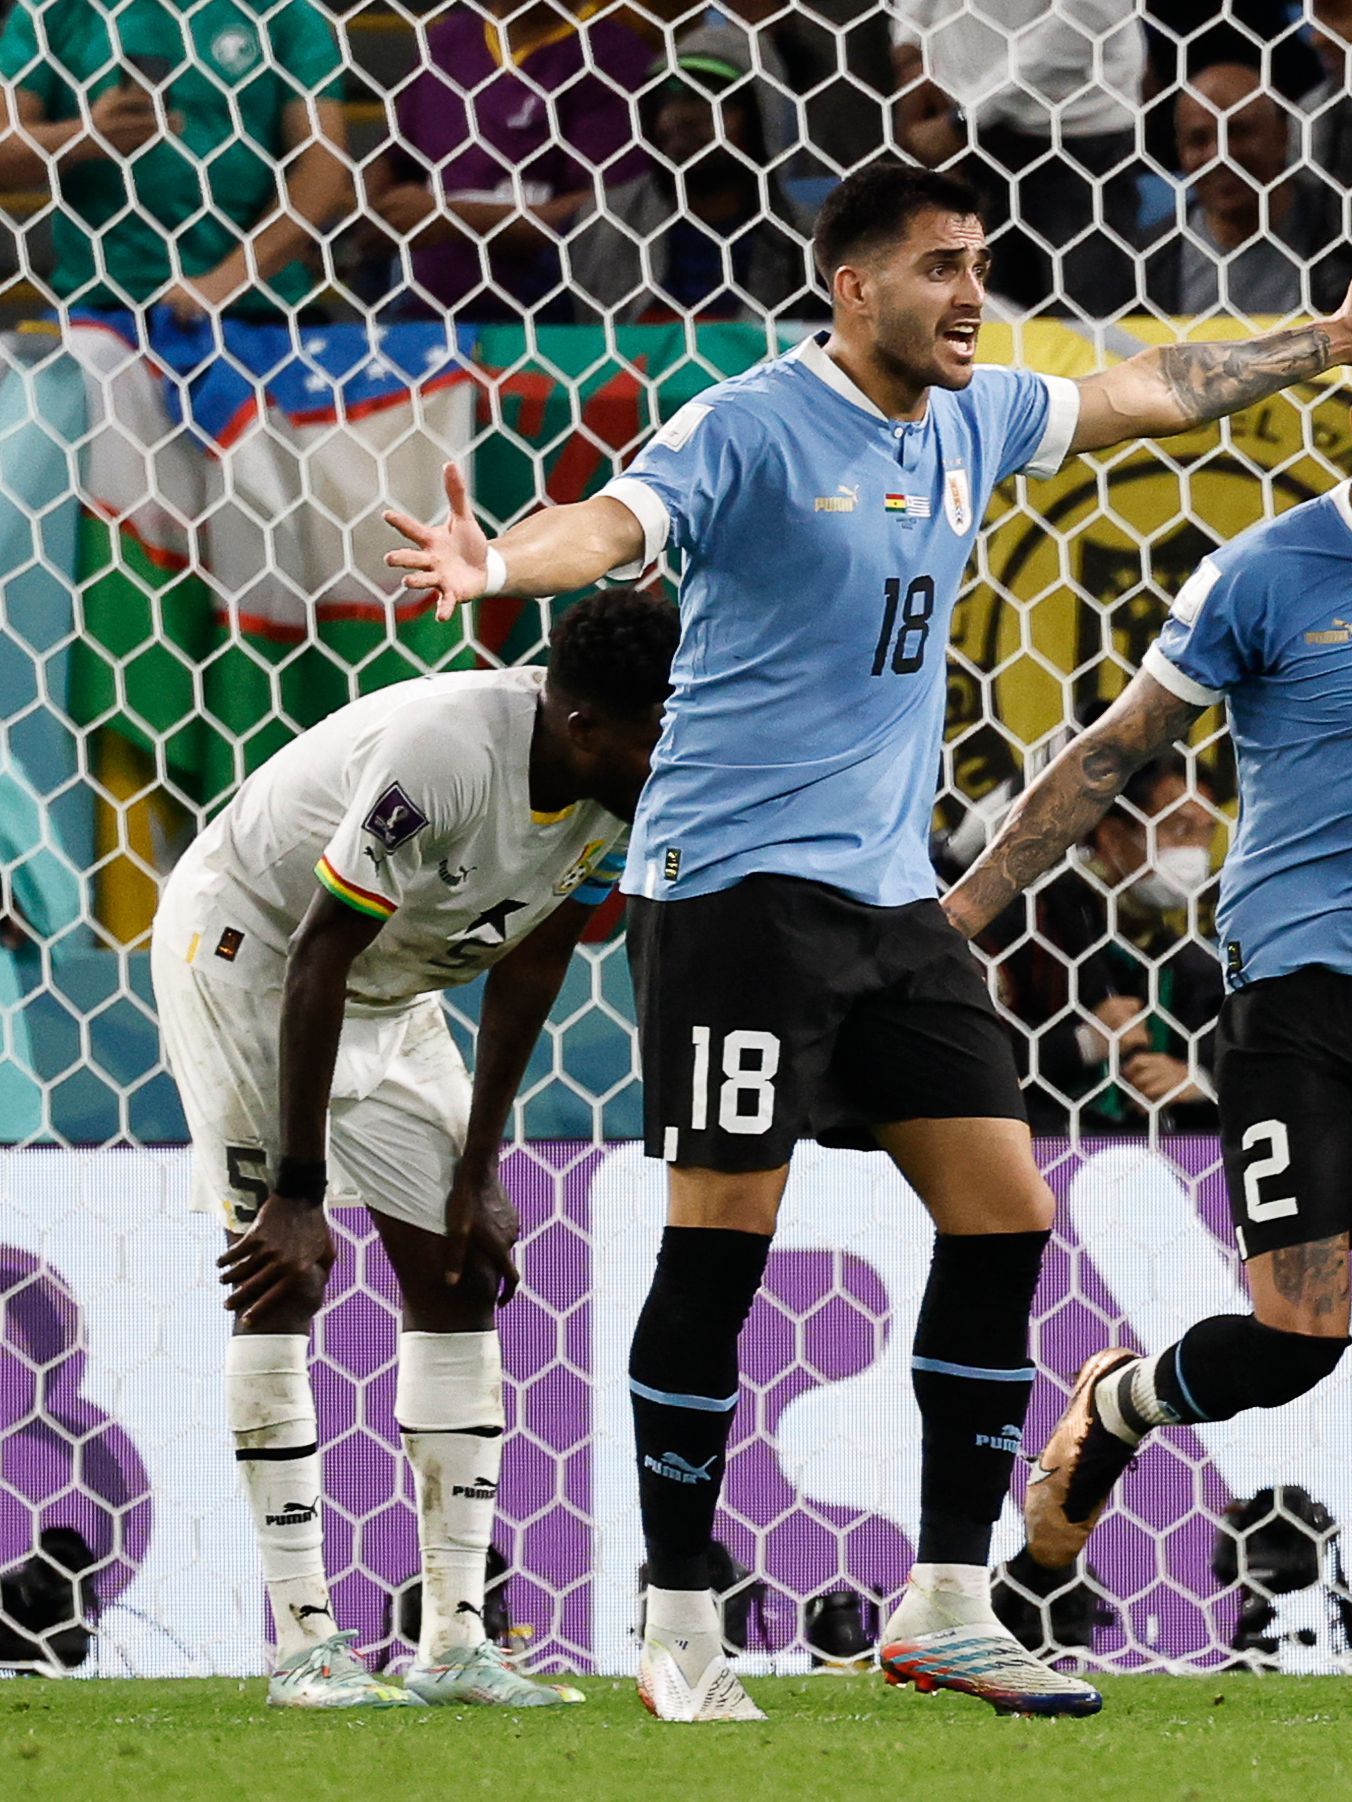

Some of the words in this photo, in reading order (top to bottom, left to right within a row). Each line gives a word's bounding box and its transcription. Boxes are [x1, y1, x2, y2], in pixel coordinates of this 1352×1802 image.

[871, 574, 935, 677] 18
[691, 1025, 781, 1135] 18
[226, 1146, 269, 1223] 5
[1242, 1119, 1299, 1223] 2
[644, 1454, 698, 1485] PUMA
[975, 1433, 1020, 1454] PUM
[265, 1511, 312, 1526] PUMA
